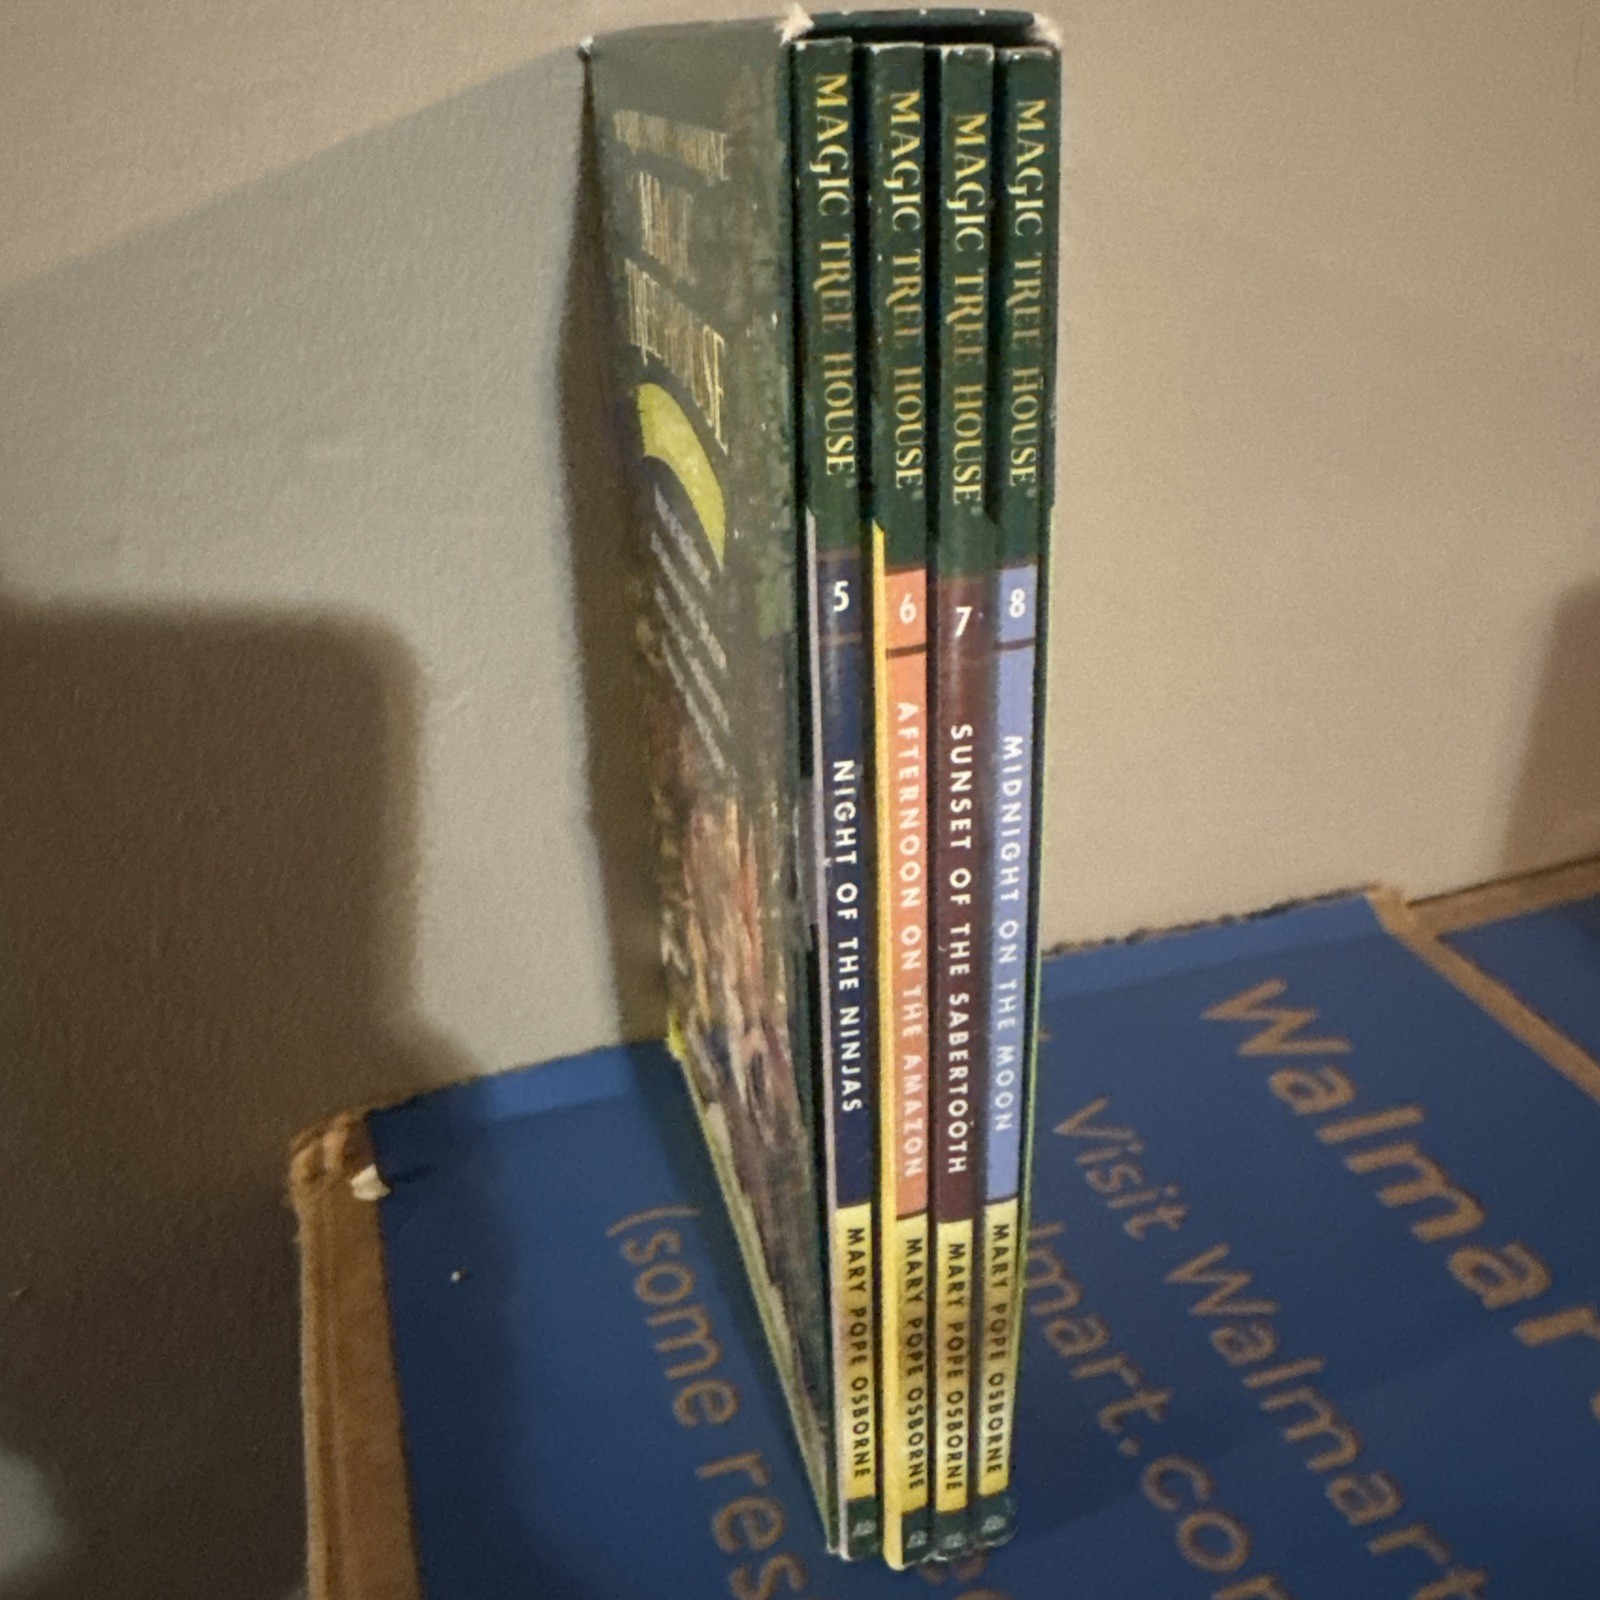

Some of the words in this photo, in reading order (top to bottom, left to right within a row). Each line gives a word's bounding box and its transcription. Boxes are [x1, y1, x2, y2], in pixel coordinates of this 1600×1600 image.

[810, 74, 850, 216] MAGIC
[883, 90, 921, 231] MAGIC
[946, 113, 988, 251] MAGIC
[1007, 99, 1047, 237] MAGIC
[813, 233, 852, 332] TREE
[886, 248, 922, 346] TREE
[946, 268, 985, 365] TREE
[1006, 253, 1042, 348] TREE
[823, 353, 855, 475] HOUSE
[894, 367, 923, 488] HOUSE
[953, 384, 983, 504] HOUSE
[1009, 367, 1040, 487] HOUSE
[833, 580, 850, 612] 5
[899, 593, 917, 624] 6
[955, 605, 972, 637] 7
[1008, 588, 1026, 618] 8
[833, 759, 858, 864] NIGHT
[897, 701, 922, 908] AFTERNOON
[950, 724, 973, 849] SUNSET
[1001, 735, 1024, 902] MIDNIGHT
[836, 882, 858, 920] OF
[950, 868, 972, 905] OF
[837, 937, 859, 990] THE
[901, 925, 922, 970] ON
[949, 923, 971, 976] THE
[998, 920, 1019, 964] ON
[902, 984, 923, 1038] THE
[997, 978, 1018, 1030] THE
[839, 1006, 862, 1112] NINJAS
[948, 992, 970, 1174] SABERTOOTH
[995, 1046, 1016, 1131] MOON
[903, 1054, 923, 1178] AMAZON
[1053, 1095, 1190, 1241] Visit
[1202, 976, 1600, 1422] Walmar
[847, 1227, 866, 1293] MARY
[906, 1238, 923, 1303] MARY
[948, 1243, 966, 1307] MARY
[991, 1224, 1010, 1288] MARY
[849, 1306, 868, 1365] POPE
[906, 1317, 923, 1377] POPE
[947, 1320, 965, 1378] POPE
[989, 1303, 1007, 1360] POPE
[605, 1204, 741, 1428] (some
[696, 1449, 810, 1600] res
[851, 1377, 871, 1478] OSBORNE
[906, 1387, 925, 1490] OSBORNE
[946, 1391, 964, 1491] OSBORNE
[986, 1372, 1005, 1474] OSBORNE
[1026, 1221, 1298, 1600] lmart.co
